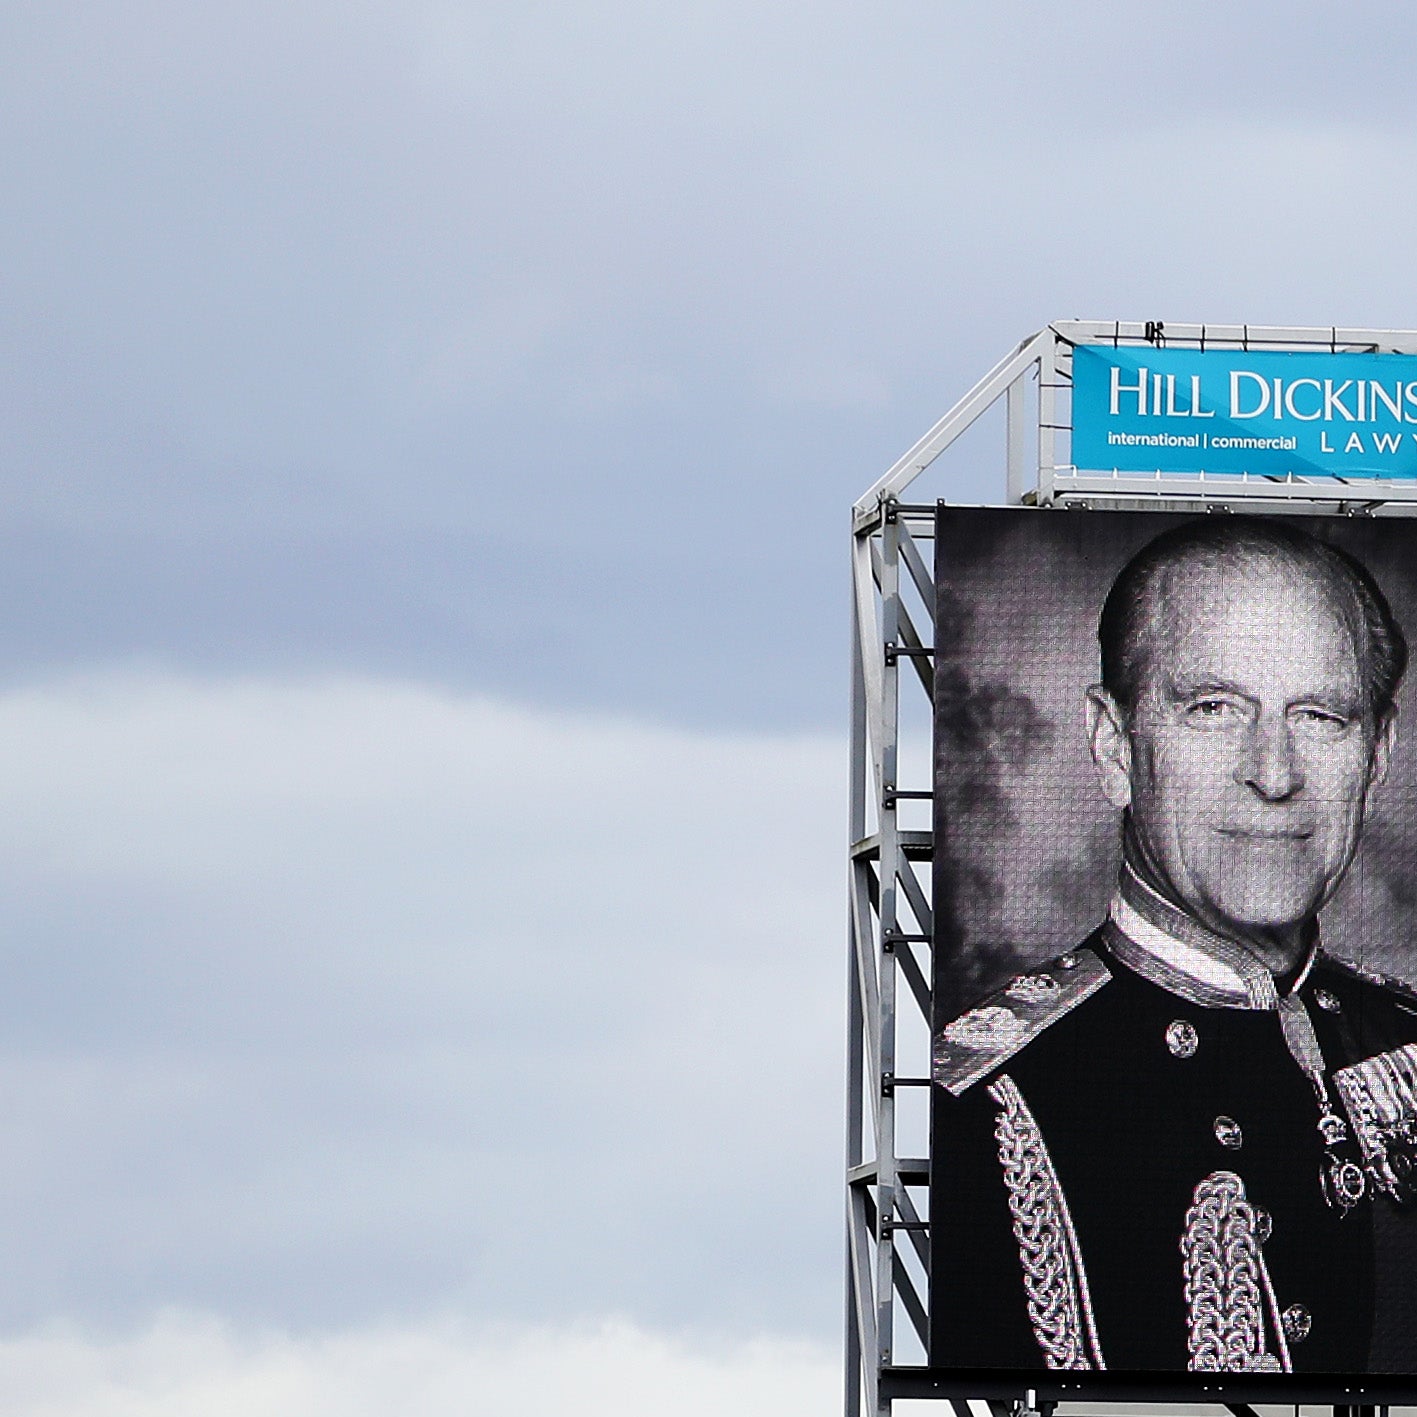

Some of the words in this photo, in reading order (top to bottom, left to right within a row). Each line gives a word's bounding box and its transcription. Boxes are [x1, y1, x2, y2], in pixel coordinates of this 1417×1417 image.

[1108, 367, 1214, 417] HILL
[1108, 433, 1199, 448] international
[1211, 435, 1296, 450] commercial
